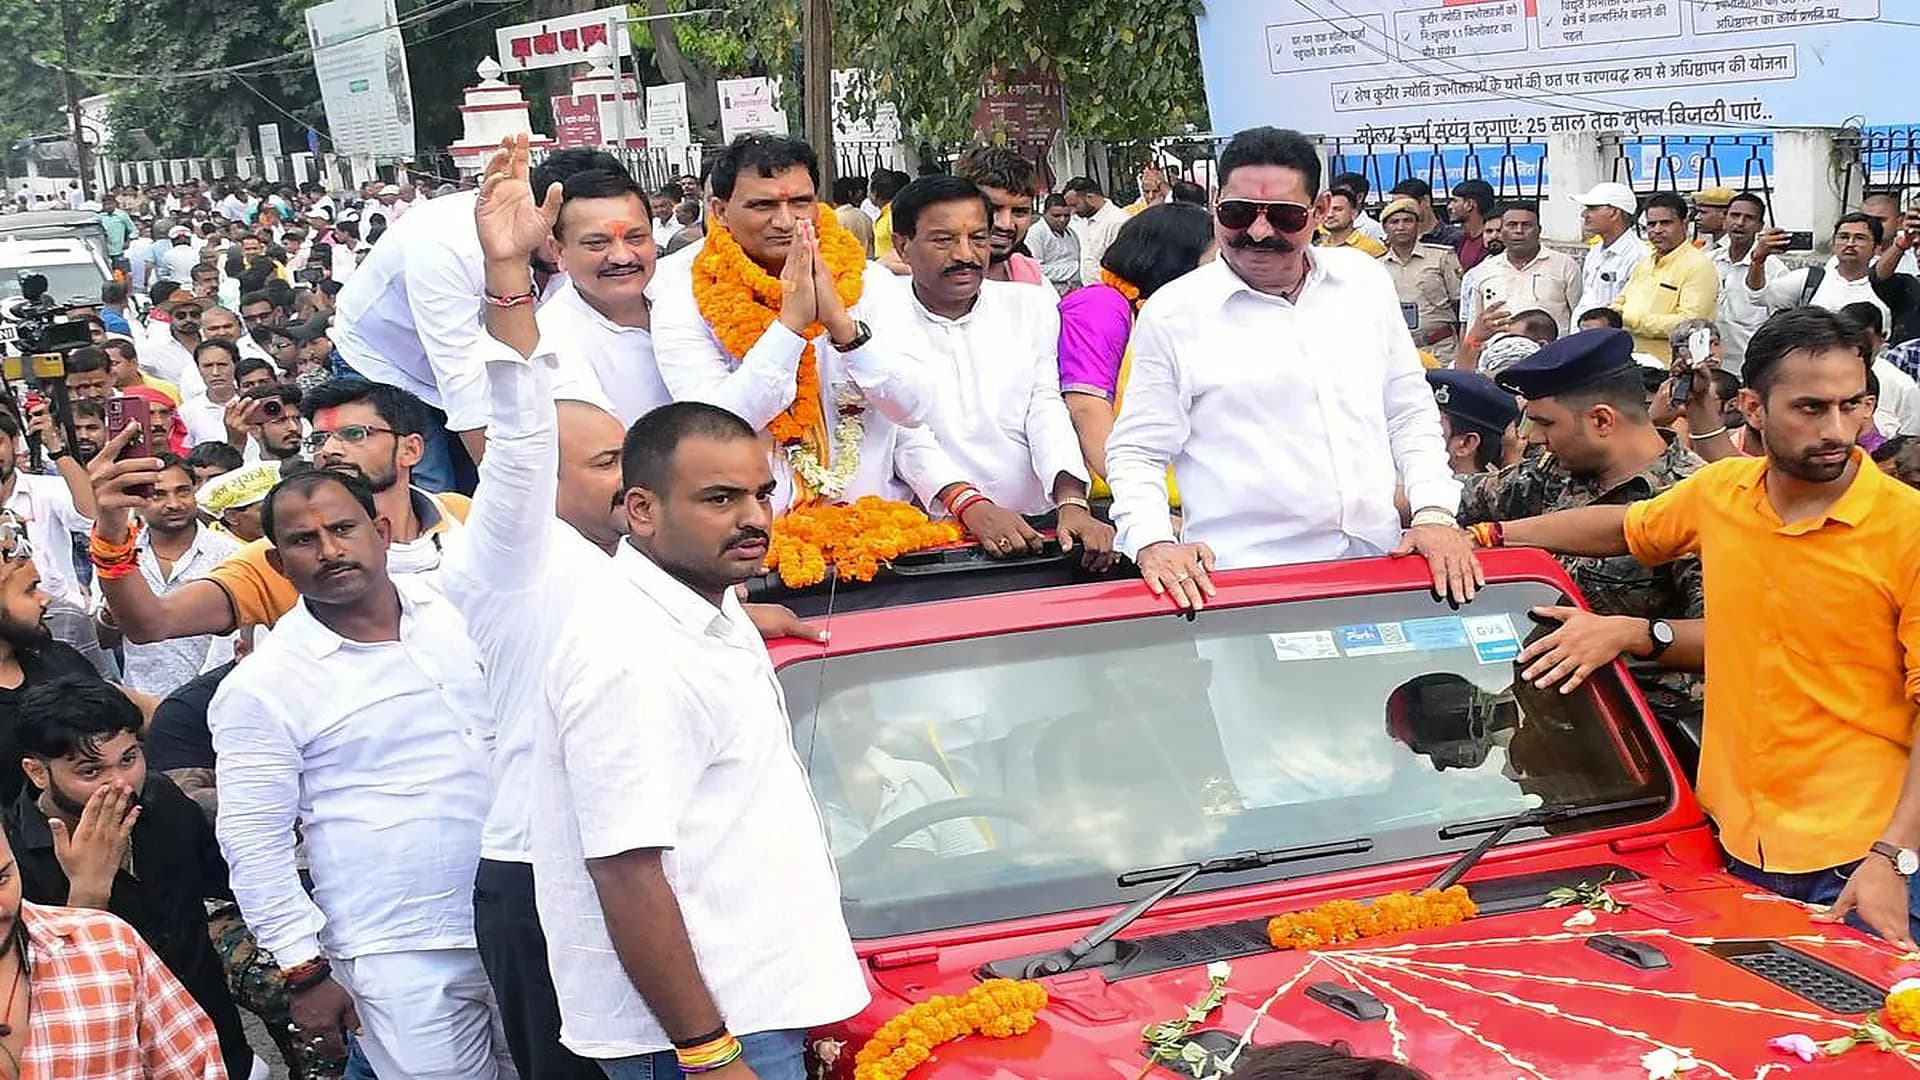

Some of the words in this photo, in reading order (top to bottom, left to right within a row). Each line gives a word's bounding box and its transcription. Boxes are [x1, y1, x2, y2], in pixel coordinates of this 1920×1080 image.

[1373, 83, 1399, 105] कुटीर
[1401, 81, 1430, 98] ज्योति
[1526, 71, 1542, 89] की
[1544, 73, 1562, 87] छत
[1565, 72, 1580, 85] पर
[1654, 61, 1666, 79] से
[1728, 54, 1745, 73] की
[1749, 53, 1788, 71] योजना
[1527, 117, 1547, 134] 25
[1550, 113, 1586, 132] साल
[1590, 111, 1620, 130] तक
[1668, 98, 1727, 124] बिजली
